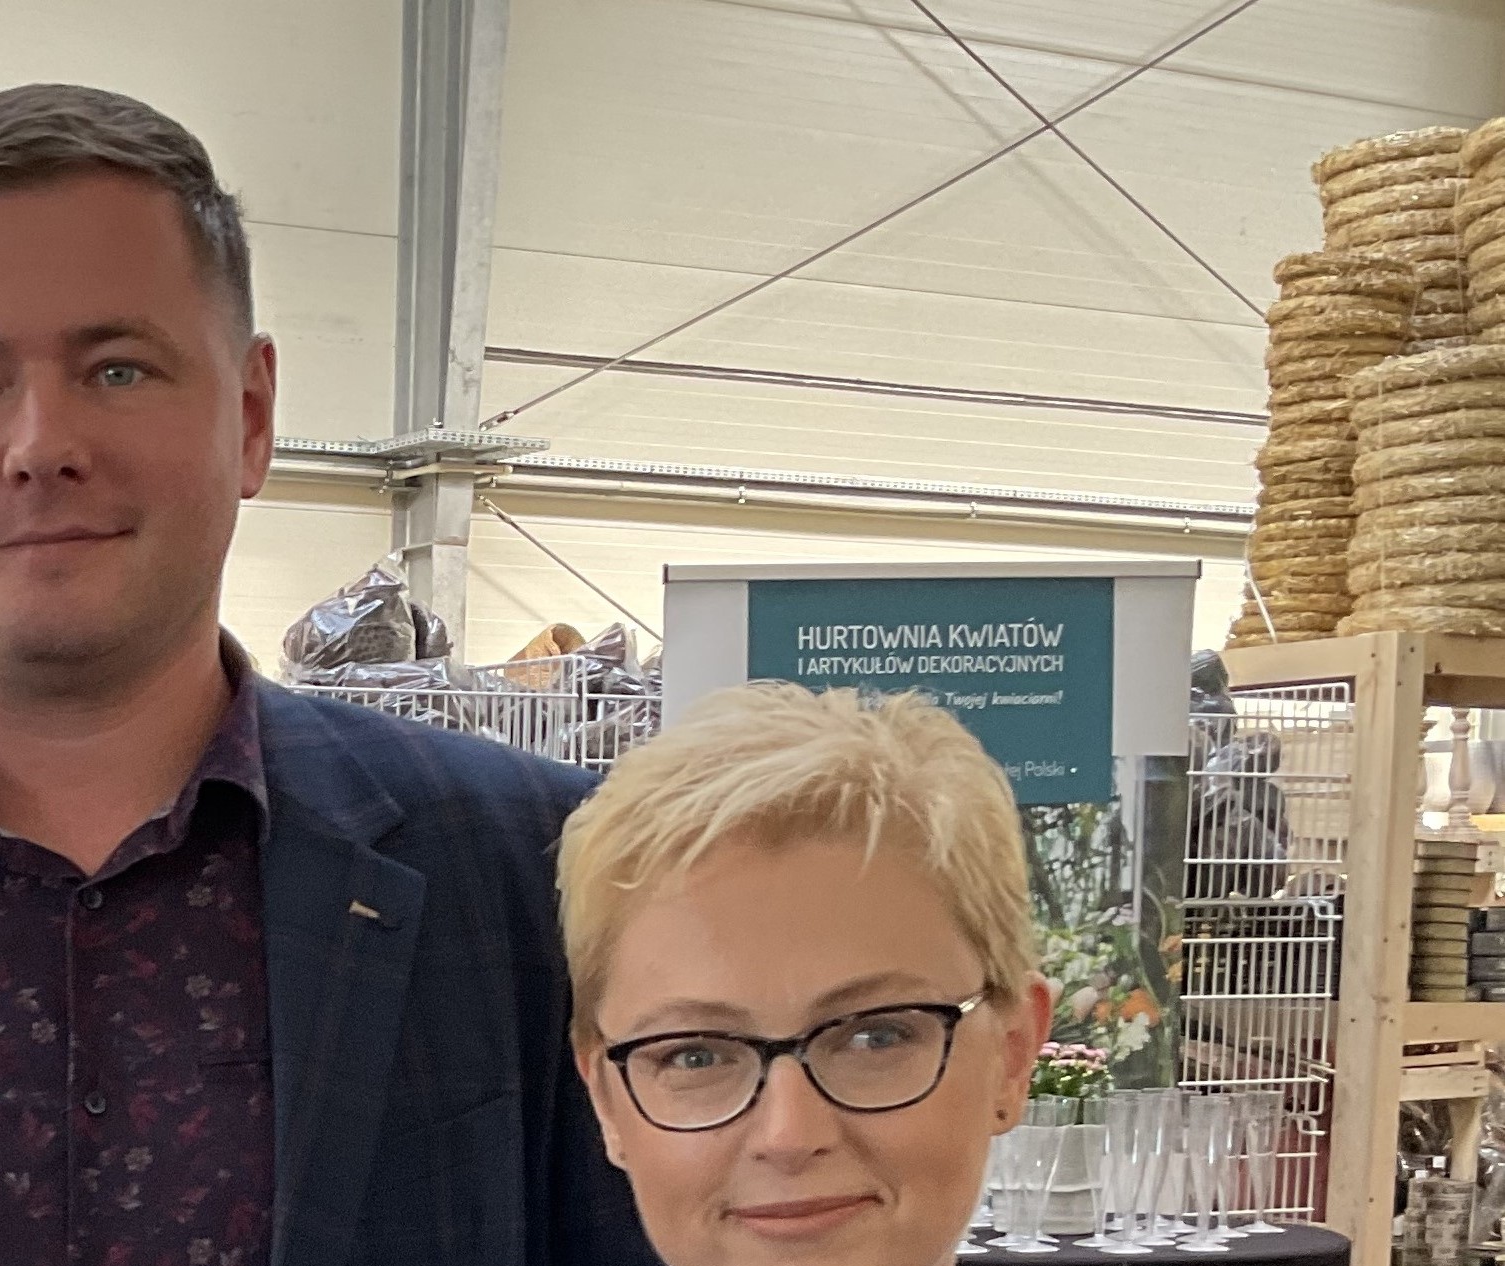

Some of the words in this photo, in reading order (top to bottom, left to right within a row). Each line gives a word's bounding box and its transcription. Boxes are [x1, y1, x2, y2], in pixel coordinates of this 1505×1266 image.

[798, 624, 943, 650] HURTOWNIA
[948, 617, 1064, 649] KWIATÓW
[798, 657, 803, 675] I
[806, 651, 914, 675] ARTYKUŁÓW
[917, 655, 1064, 674] DEKORACYJNYCH
[944, 691, 989, 709] Twojej
[1024, 760, 1066, 777] Polski
